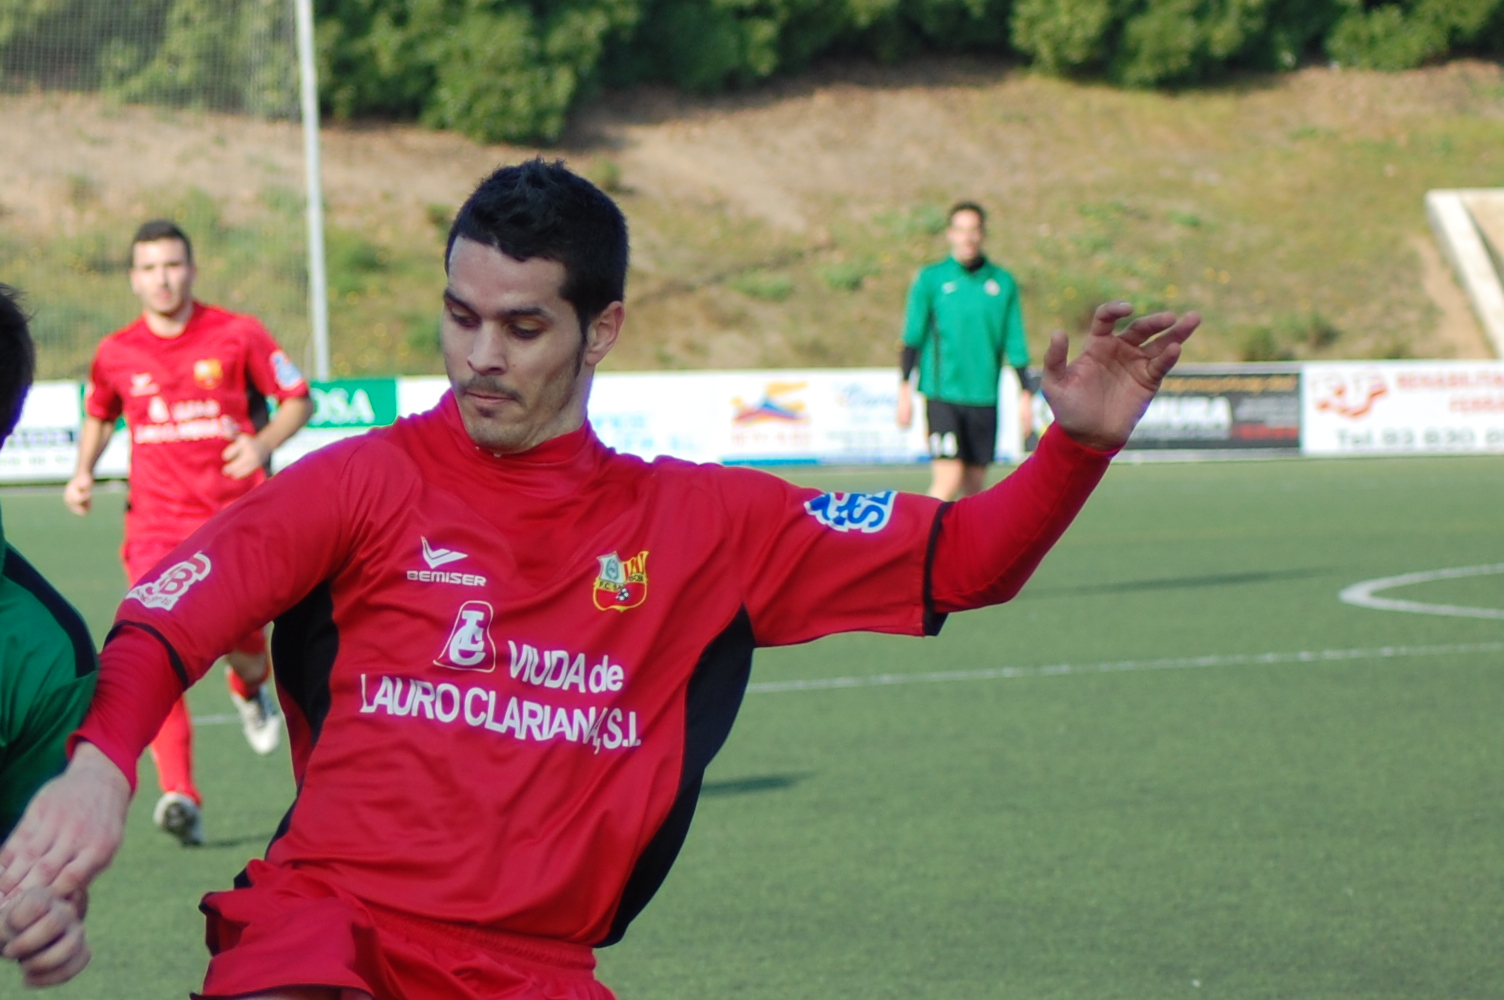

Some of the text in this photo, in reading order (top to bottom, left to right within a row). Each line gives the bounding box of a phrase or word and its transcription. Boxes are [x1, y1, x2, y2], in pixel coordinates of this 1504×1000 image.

[406, 570, 487, 587] BEMISER
[507, 640, 624, 693] VIUDA de
[360, 674, 460, 723] LAURO
